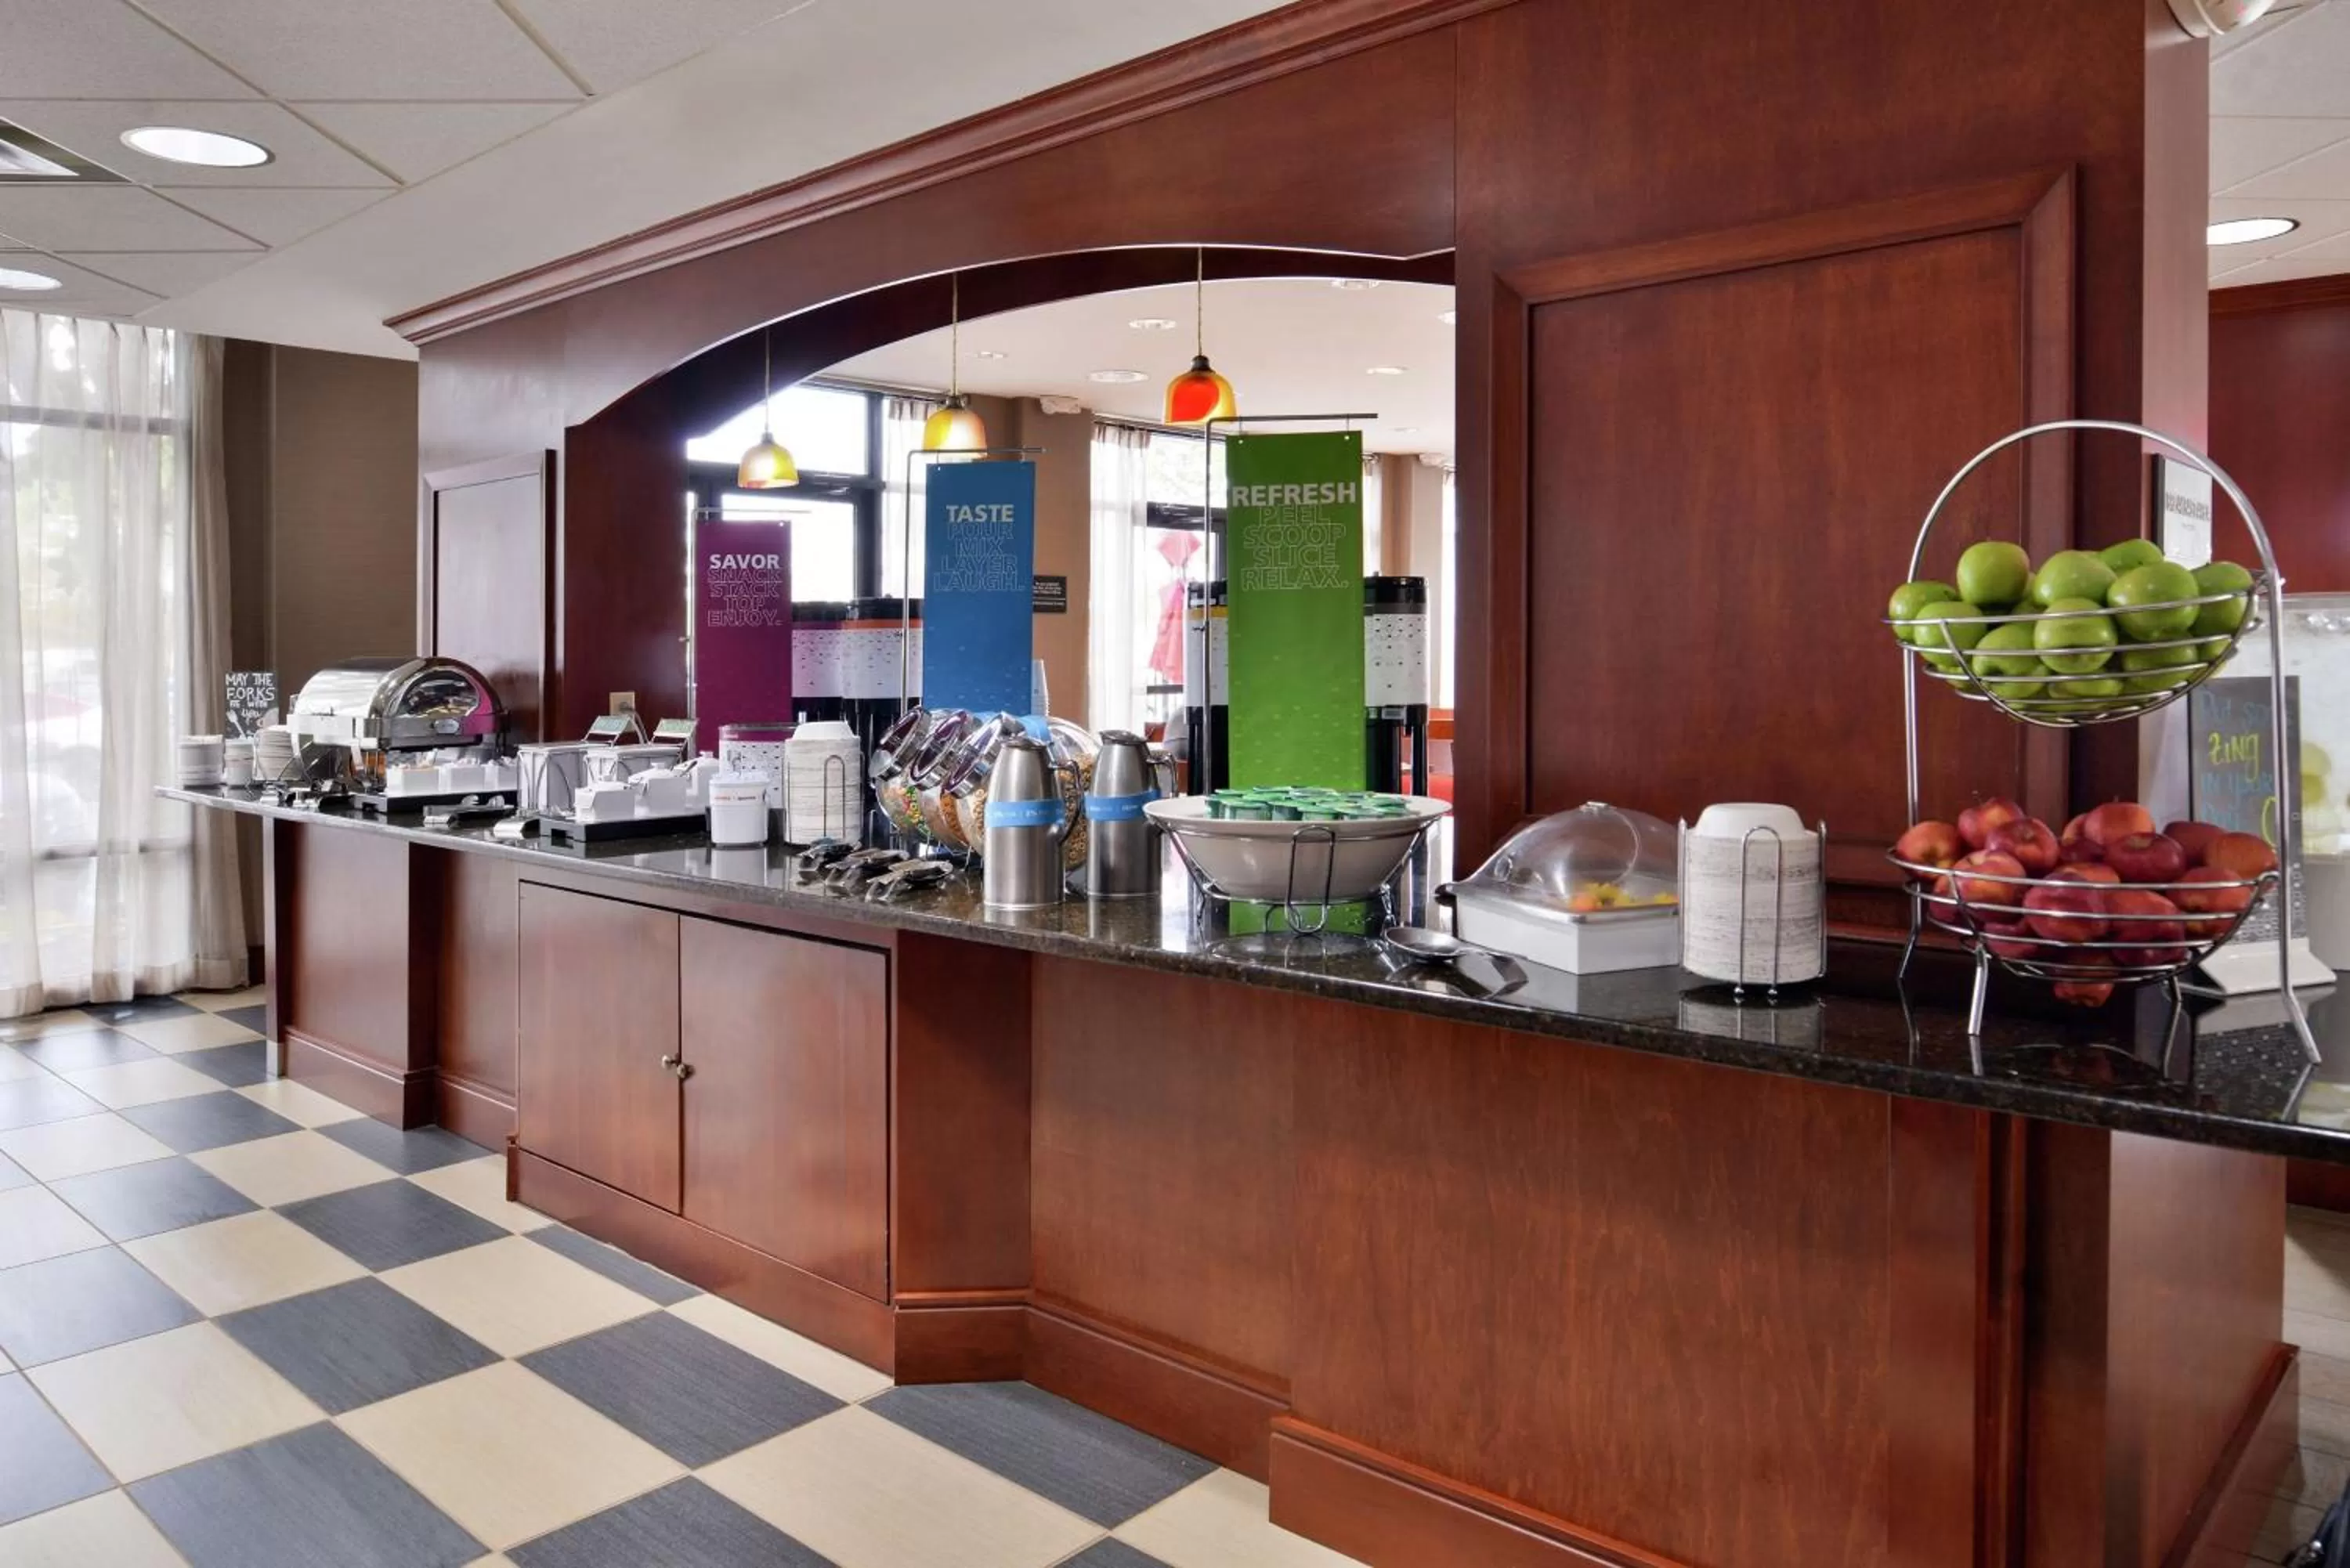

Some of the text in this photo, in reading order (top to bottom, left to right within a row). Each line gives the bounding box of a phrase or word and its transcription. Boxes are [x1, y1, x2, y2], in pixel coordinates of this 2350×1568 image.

[1231, 482, 1357, 507] REFRESH
[946, 504, 1014, 522] TASTE
[1259, 505, 1330, 526] PEEL
[947, 521, 1014, 540] POUR
[1243, 524, 1347, 548] SCOOP
[955, 538, 1003, 556] MIX
[709, 553, 780, 569] SAVOR
[941, 555, 1018, 574] LAYER
[1253, 545, 1336, 569] SLICE
[707, 569, 783, 583] SNACK
[933, 573, 1025, 592] LAUGH.
[1241, 565, 1350, 591] RELAX.
[710, 582, 779, 598] STACK
[225, 672, 273, 686] MAY THE
[226, 687, 276, 702] FORKS
